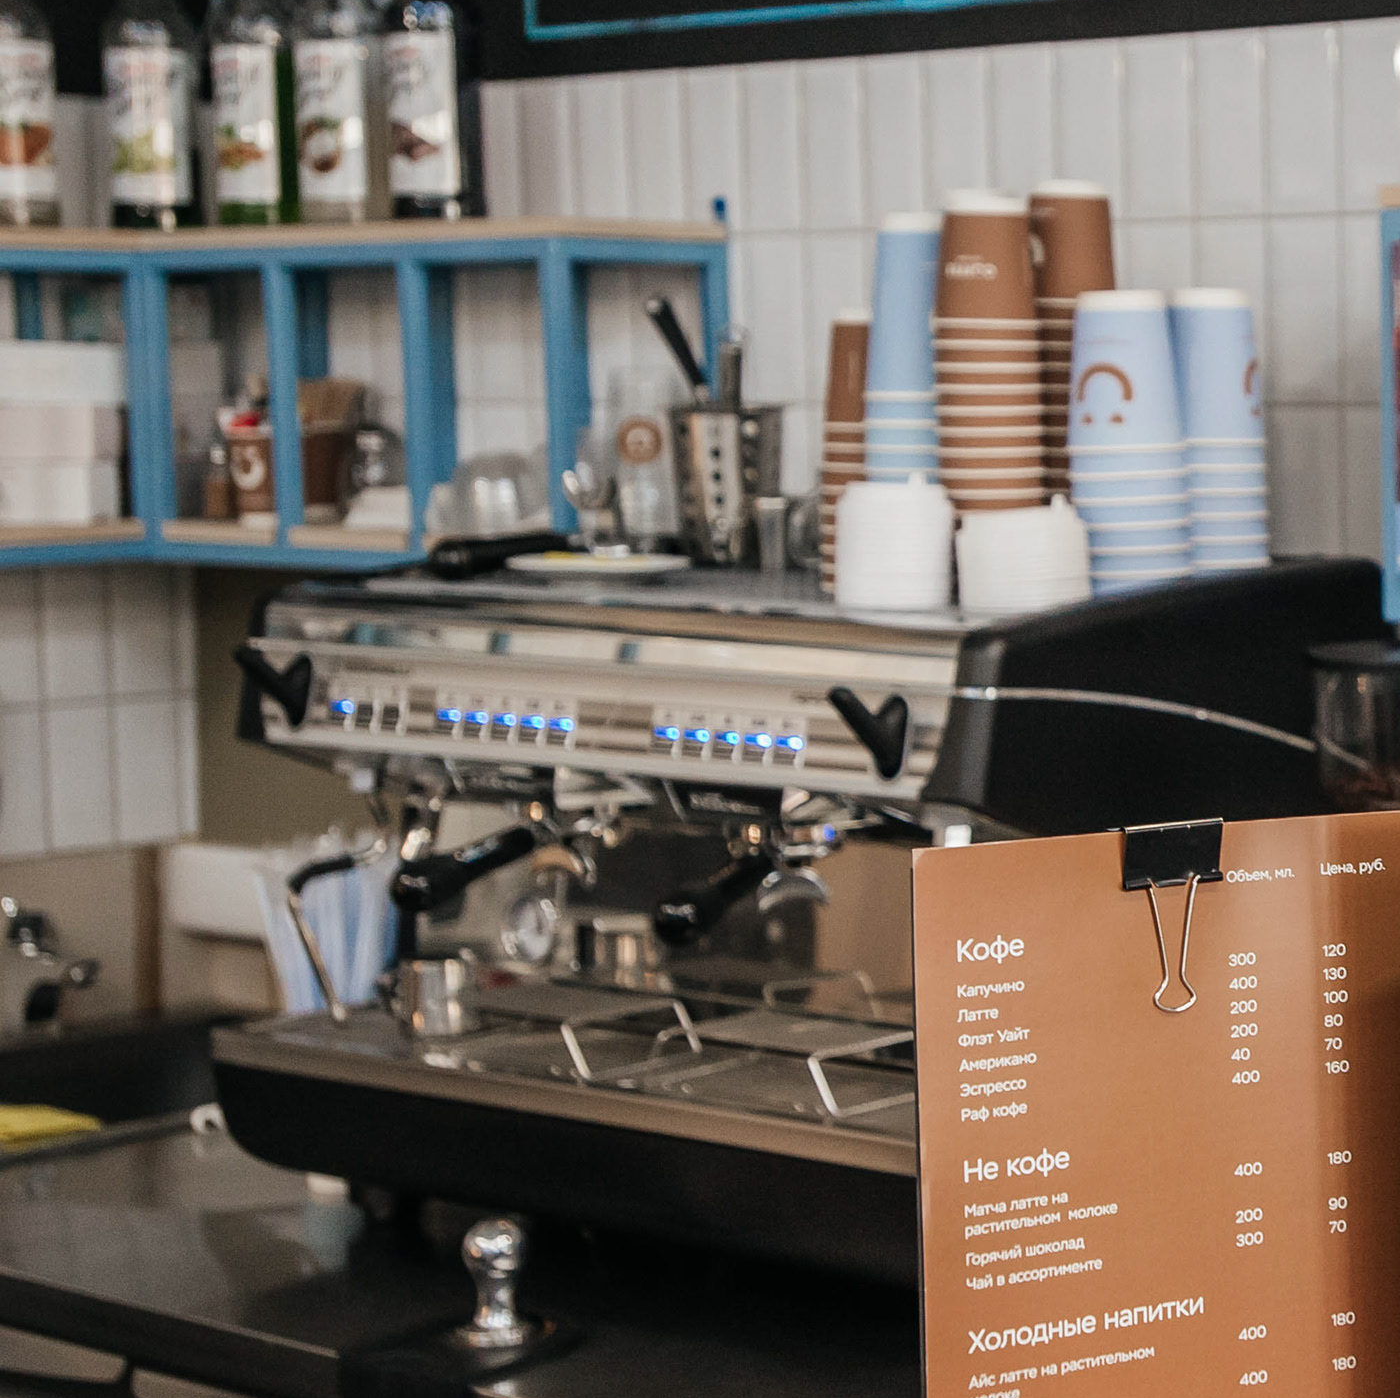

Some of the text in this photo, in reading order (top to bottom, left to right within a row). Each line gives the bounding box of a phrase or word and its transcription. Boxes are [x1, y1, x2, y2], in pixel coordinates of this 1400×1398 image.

[1226, 867, 1294, 883] Объем, мл.
[1320, 859, 1385, 877] Цена, руб.
[956, 935, 1024, 963] Кофе
[1322, 943, 1346, 957] 120
[1228, 953, 1256, 966] 300
[1229, 976, 1258, 990] 400
[1323, 967, 1347, 981] 130
[957, 979, 1025, 999] Капучино
[1324, 990, 1348, 1004] 100
[957, 1006, 999, 1023] Латте
[1230, 1000, 1258, 1013] 200
[1324, 1014, 1343, 1027] 80
[958, 1027, 1030, 1048] Флэт Уайт
[1325, 1037, 1342, 1050] 70
[959, 1051, 1037, 1072] Американо
[1231, 1048, 1250, 1061] 40
[960, 1077, 1027, 1098] Эспрессо
[961, 1101, 1028, 1123] Раф кофе
[963, 1147, 1070, 1182] Не кофе
[965, 1191, 1068, 1218] Матча латте на
[965, 1202, 1118, 1239] растительном молоке
[966, 1235, 1085, 1266] Горячий шоколад
[966, 1257, 1102, 1291] Чай в ассортименте
[968, 1296, 1205, 1354] Холодные напитки
[1331, 1312, 1355, 1326] 180
[969, 1345, 1155, 1389] Айс латте на растительном
